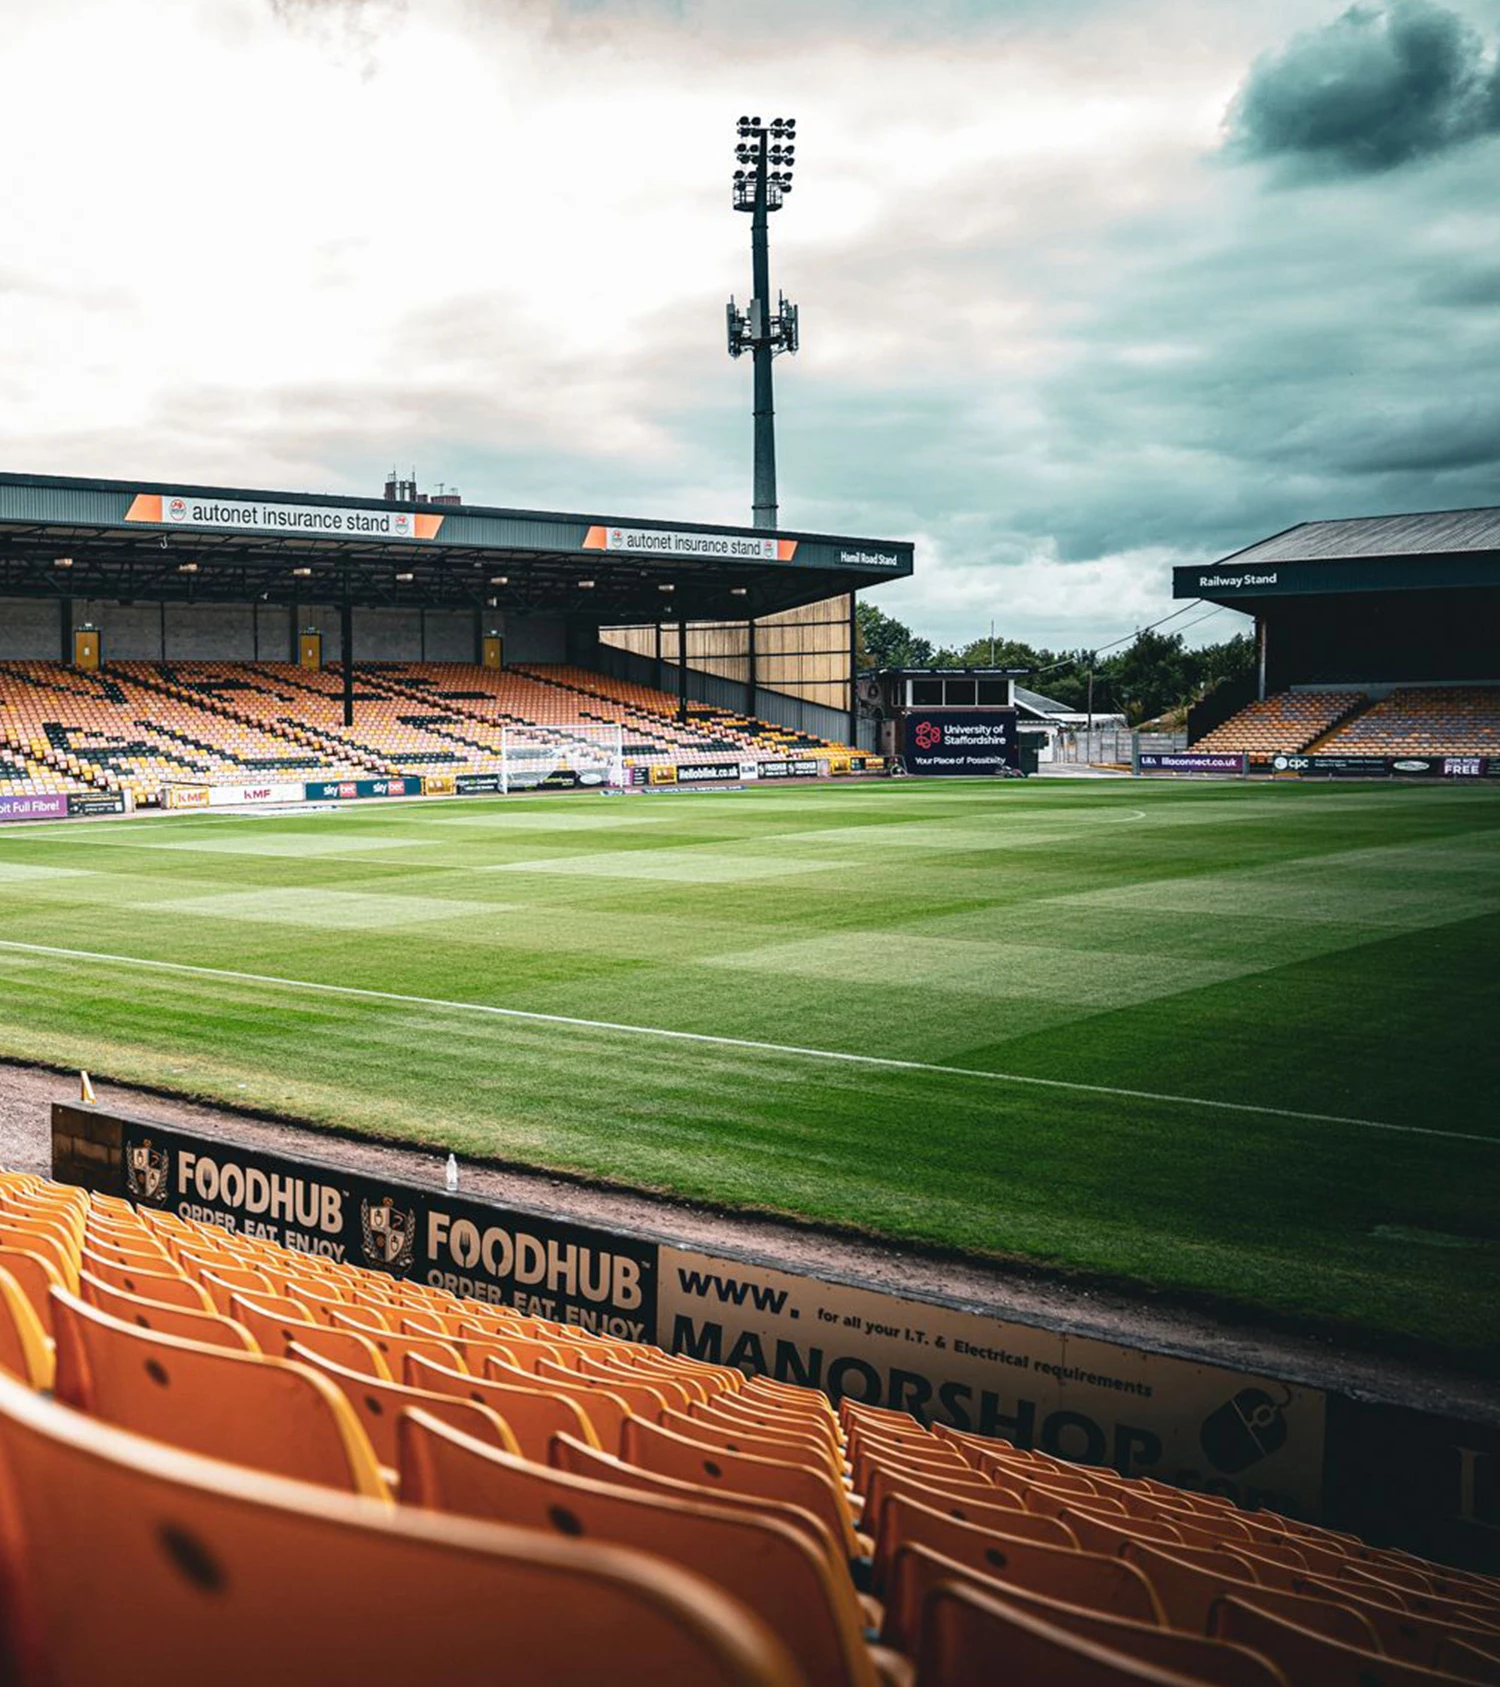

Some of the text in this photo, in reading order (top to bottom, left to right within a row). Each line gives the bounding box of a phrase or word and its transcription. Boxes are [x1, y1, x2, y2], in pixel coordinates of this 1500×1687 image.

[193, 503, 390, 532] autonet insurance stand
[627, 533, 761, 556] autonet insurance stand
[840, 551, 898, 566] Hamil Road Stand
[1200, 573, 1277, 588] Railway Stand
[944, 724, 1004, 736] University of
[944, 735, 1006, 745] Staffordshire
[915, 757, 933, 765] Your
[933, 757, 955, 765] Place
[956, 757, 964, 765] of
[1161, 756, 1237, 767] lilaconnect.co.uk
[1289, 758, 1308, 770] cpc
[1444, 765, 1480, 774] FREE
[323, 784, 356, 797] sky bet
[373, 780, 405, 794] sky bet
[13, 801, 30, 813] Full
[32, 800, 60, 812] Fibre!
[178, 1149, 344, 1235] FOODHUB
[427, 1209, 643, 1311] FOODHUB
[677, 1267, 800, 1320] www.
[817, 1307, 1153, 1398] for all your I.T. & Electrical requirements
[671, 1313, 1163, 1478] MANORSHOP
